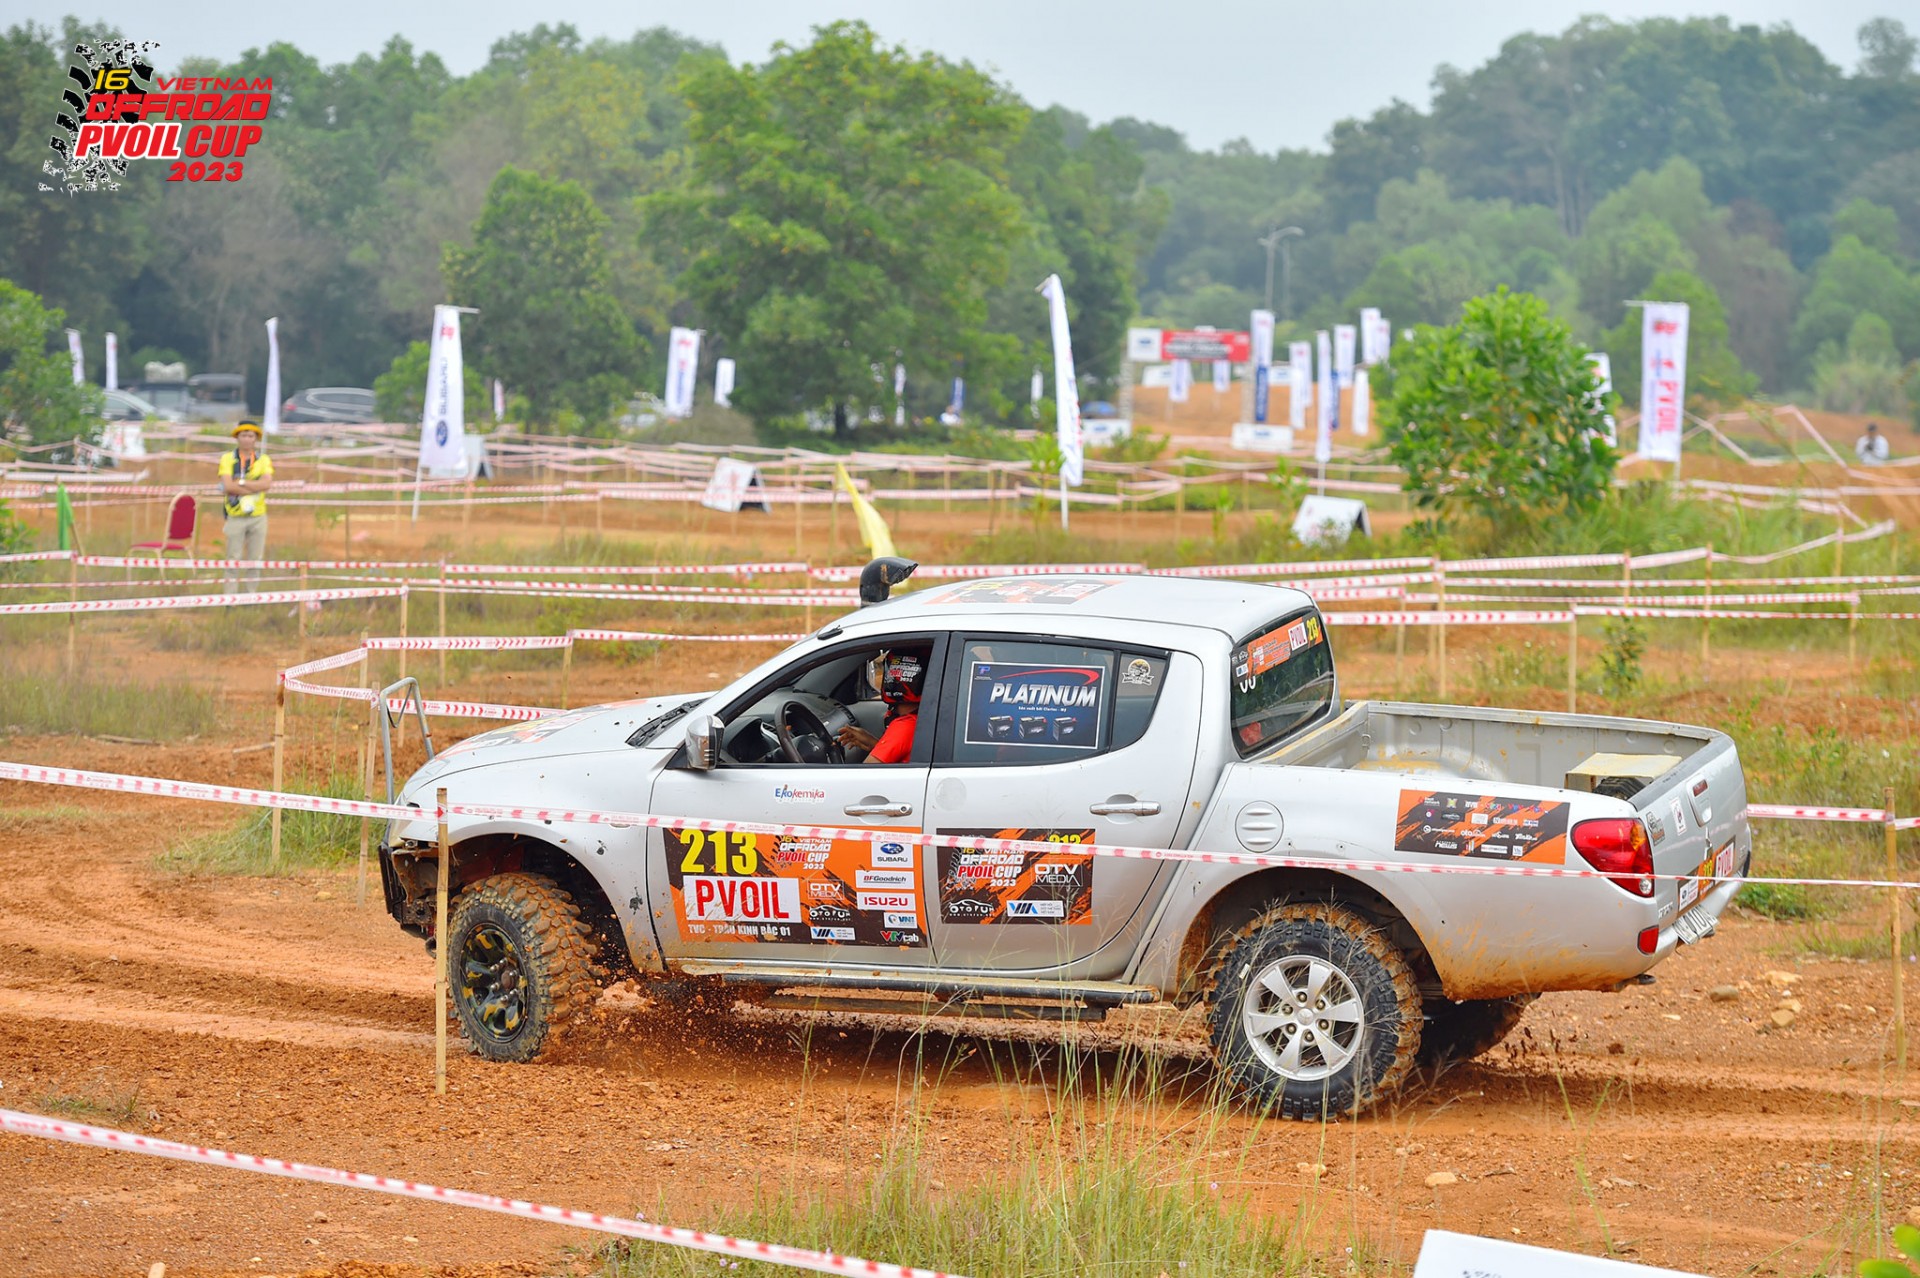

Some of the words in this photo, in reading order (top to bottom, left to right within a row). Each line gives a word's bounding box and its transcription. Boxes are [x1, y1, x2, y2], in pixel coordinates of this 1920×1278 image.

[989, 683, 1097, 707] PLATINUM
[680, 828, 757, 875] 213
[780, 842, 831, 852] OFFROAD
[778, 852, 806, 862] PVOIL
[807, 852, 829, 863] CUP
[960, 854, 1024, 865] OFFROAD
[957, 865, 994, 878] PVOIL
[995, 866, 1022, 879] CUP
[1034, 864, 1079, 874] OTV
[863, 875, 907, 883] BFGoodrich
[989, 879, 1017, 887] 2023
[1035, 873, 1081, 887] MEDIA
[810, 883, 841, 891] OTV
[695, 879, 790, 920] PVOIL
[811, 890, 843, 900] MEDIA
[864, 896, 909, 906] ISUZU
[780, 926, 791, 936] 01
